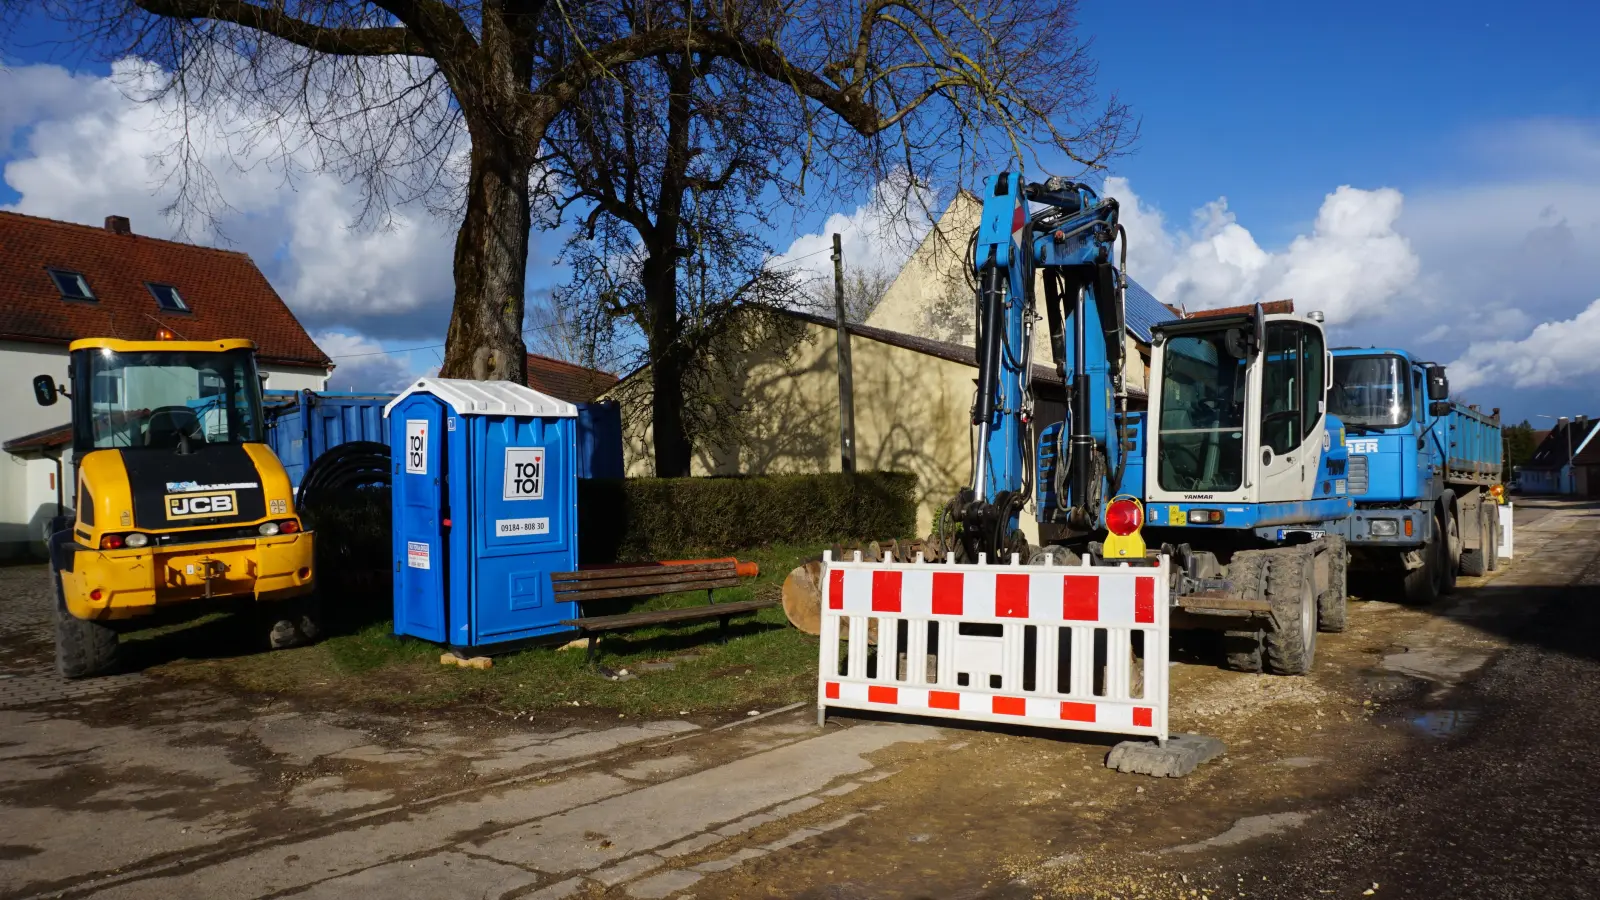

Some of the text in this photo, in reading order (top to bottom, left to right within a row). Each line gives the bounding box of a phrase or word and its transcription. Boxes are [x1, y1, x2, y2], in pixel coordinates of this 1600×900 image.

[410, 435, 424, 451] TOI
[409, 451, 424, 468] TOI
[515, 462, 540, 478] TOI
[513, 478, 539, 494] TOI
[171, 495, 233, 515] JCB
[500, 524, 520, 532] 09184
[524, 522, 536, 531] 808
[537, 522, 545, 530] 30
